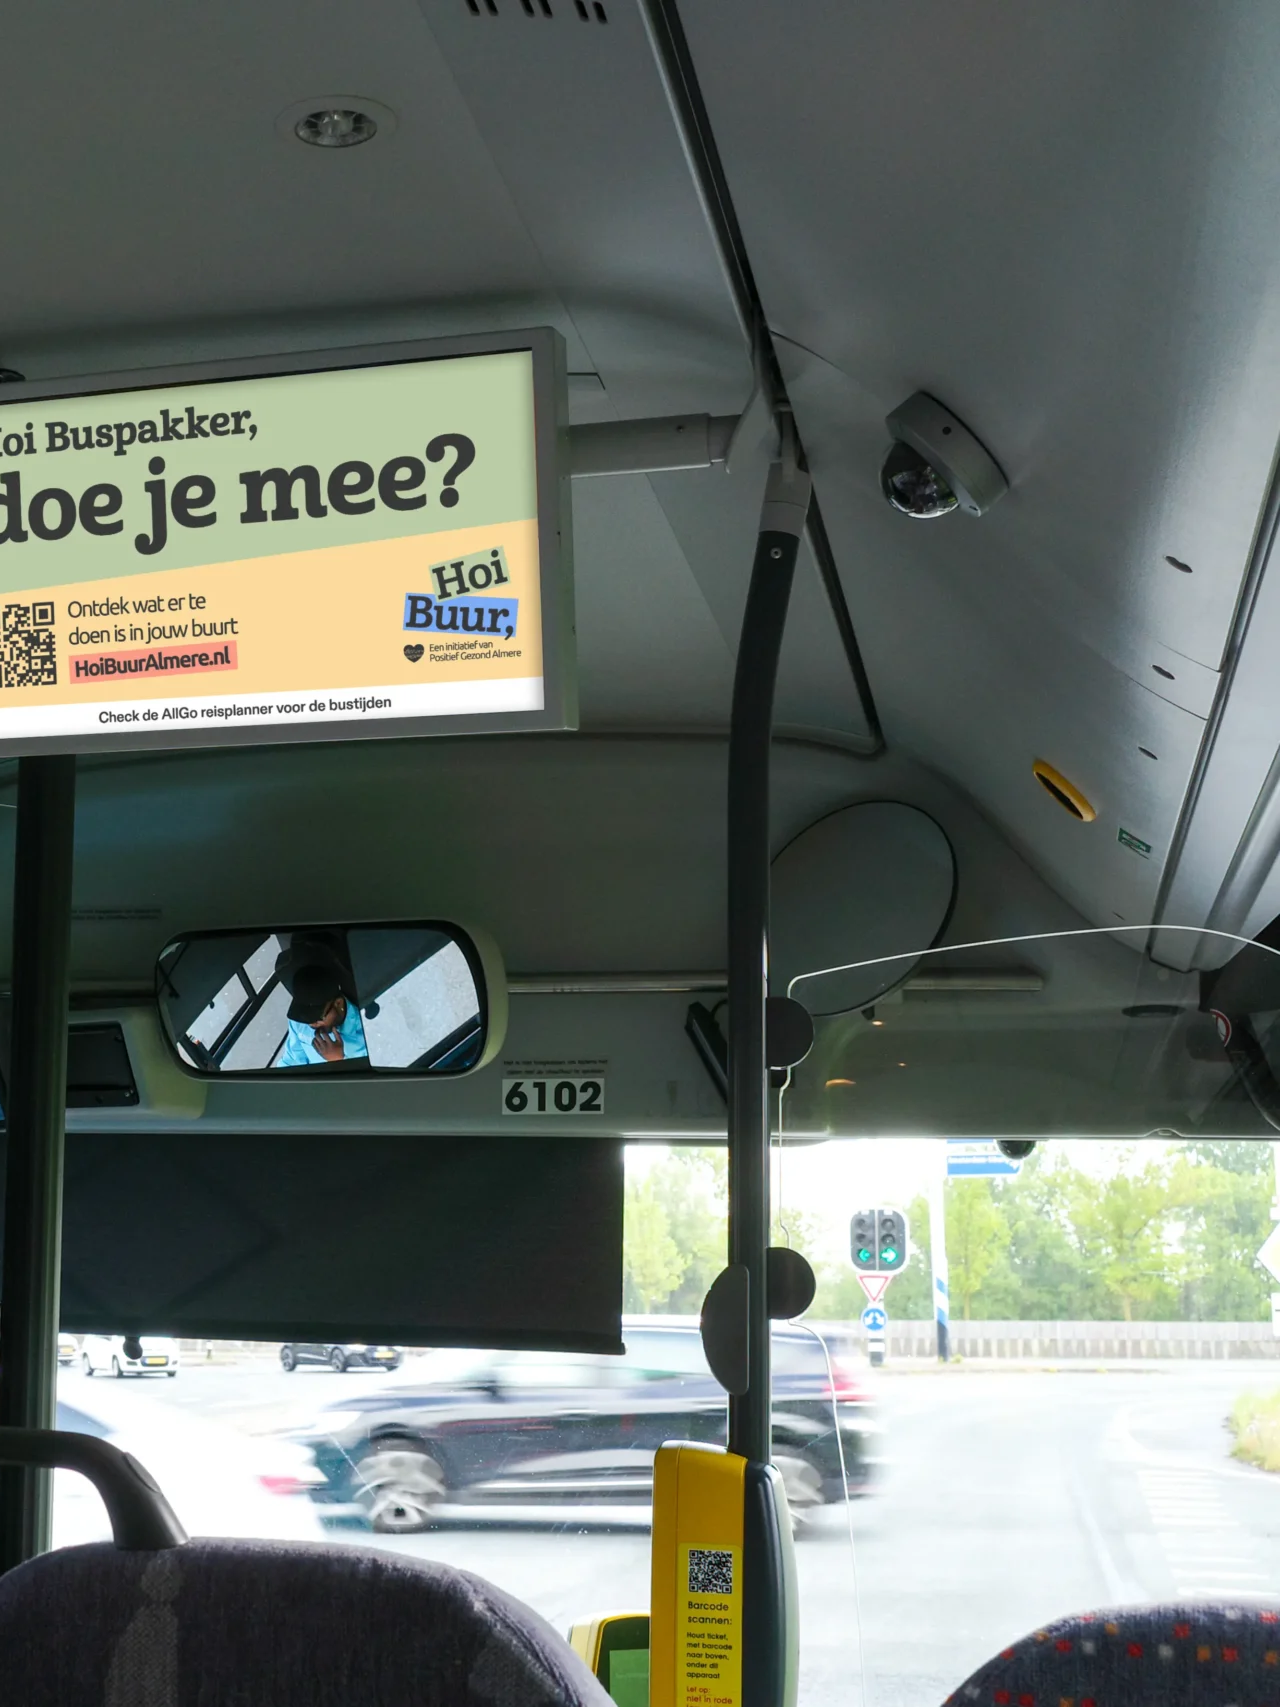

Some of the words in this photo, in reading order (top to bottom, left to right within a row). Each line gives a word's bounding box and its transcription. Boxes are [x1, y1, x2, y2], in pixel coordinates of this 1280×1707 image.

[45, 406, 259, 456] Buspakker,
[134, 456, 217, 555] je
[238, 432, 476, 524] mee?
[432, 549, 509, 599] Hoi
[67, 596, 130, 619] Ontdek
[132, 595, 164, 614] wat
[168, 595, 185, 612] er
[188, 593, 207, 610] te
[405, 597, 515, 640] Buur,
[68, 624, 111, 645] doen
[114, 623, 126, 642] is
[129, 623, 144, 641] in
[145, 620, 187, 643] jouw
[190, 617, 239, 637] buurt
[429, 643, 444, 652] Een
[445, 641, 477, 651] initiatief
[480, 640, 494, 649] van
[429, 652, 460, 663] Positief
[461, 649, 490, 661] Gezond
[491, 647, 522, 659] Almere
[75, 646, 231, 678] HoiBuurAlmere.nl
[98, 709, 139, 724] Check
[142, 709, 159, 722] de
[161, 706, 198, 722] AllGo
[200, 702, 273, 722] reisplanner
[275, 702, 306, 715] voor
[308, 700, 326, 713] de
[328, 696, 392, 713] bustijden
[505, 1080, 601, 1112] 6102
[687, 1600, 729, 1611] Barcode
[687, 1616, 732, 1625] scannen:
